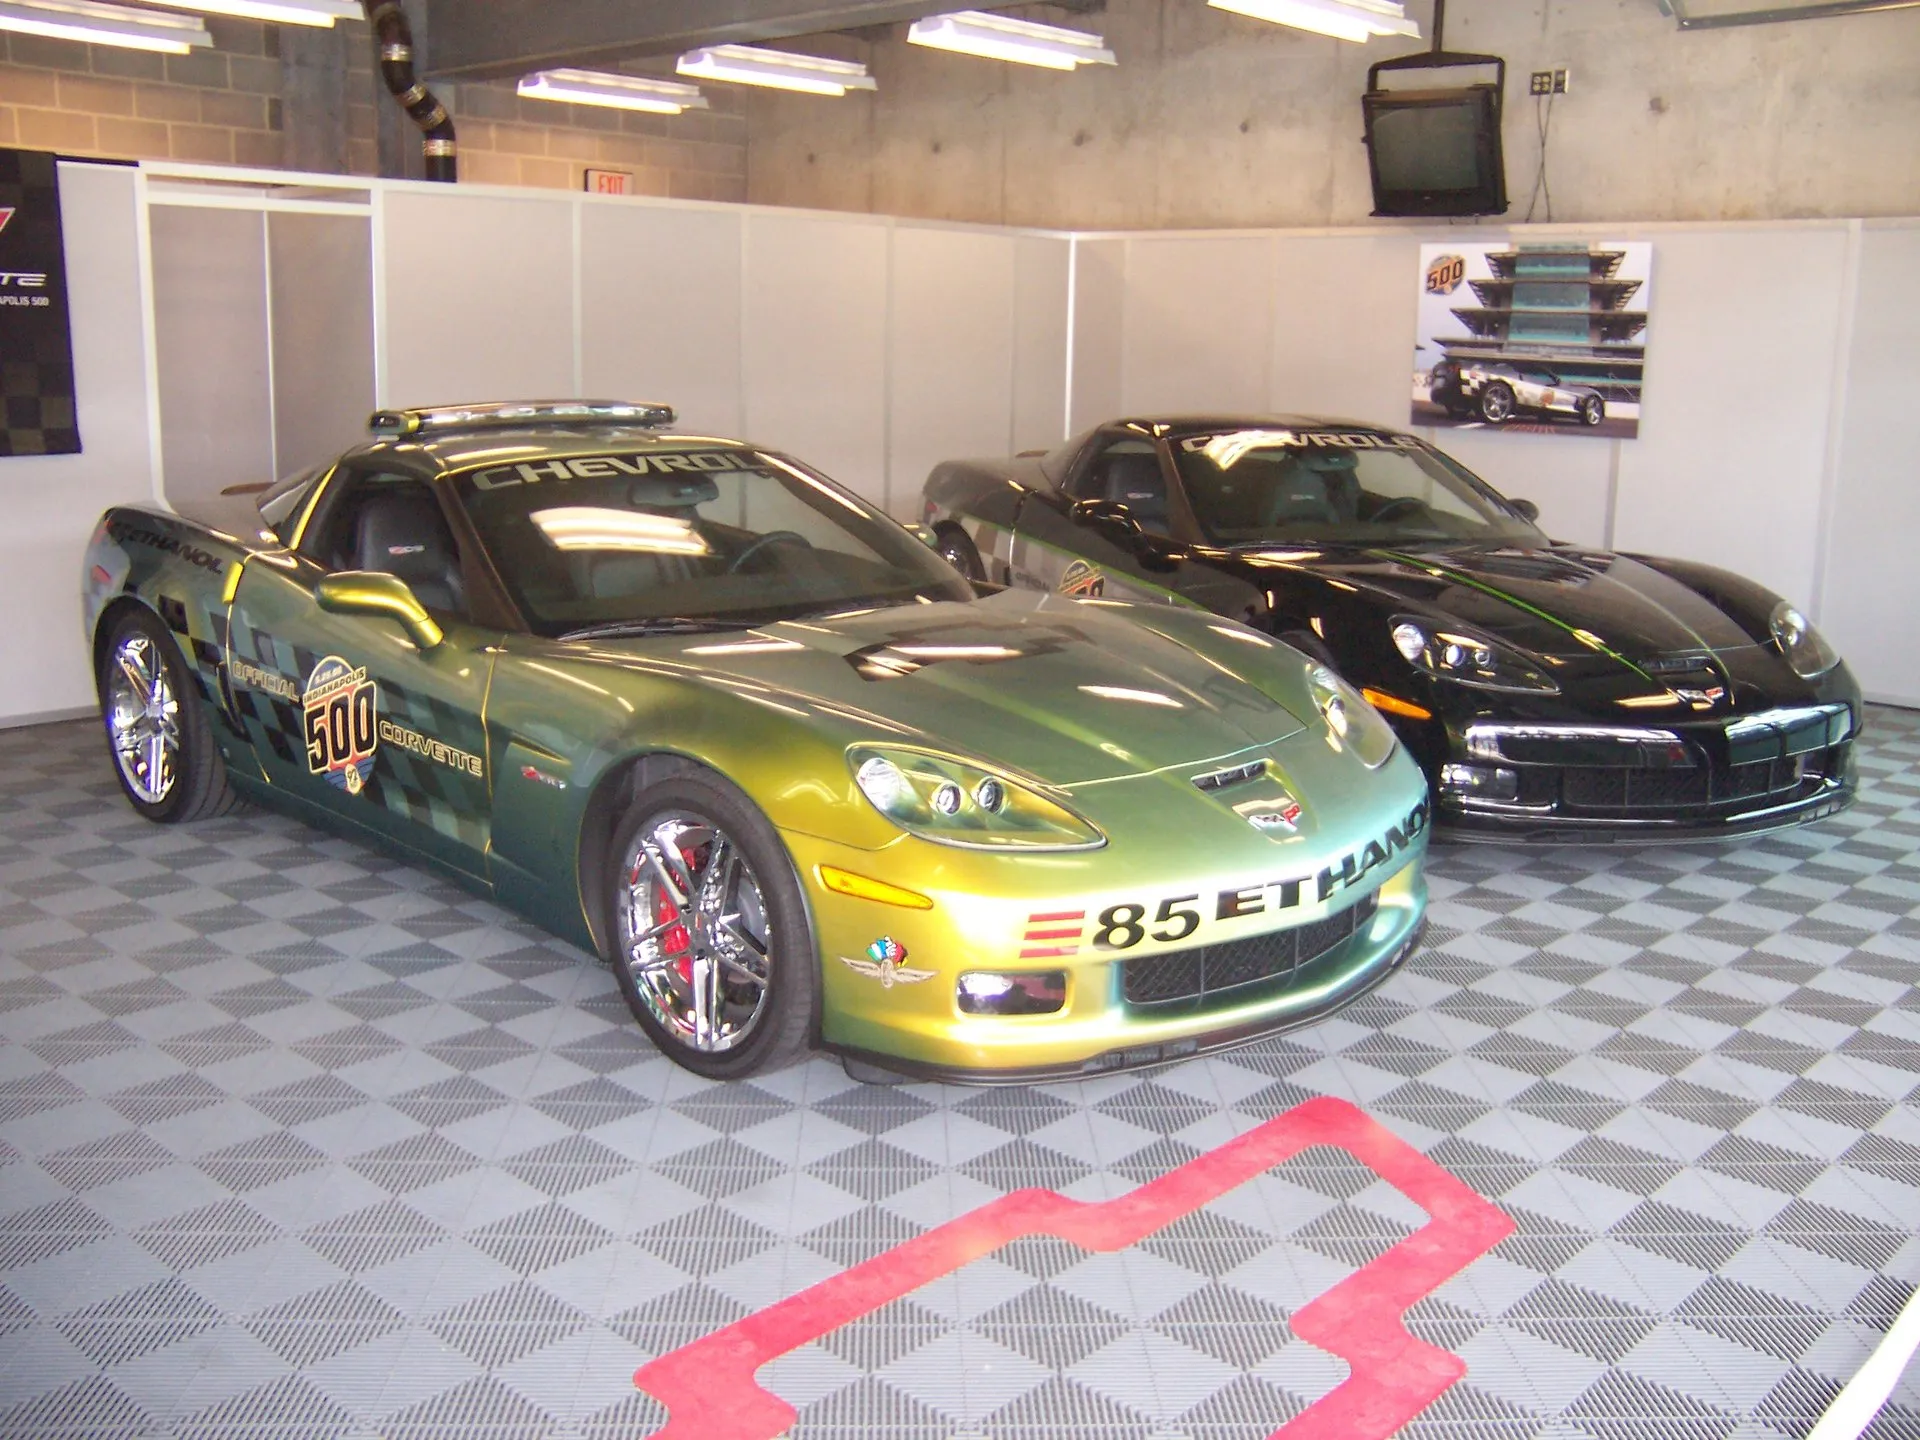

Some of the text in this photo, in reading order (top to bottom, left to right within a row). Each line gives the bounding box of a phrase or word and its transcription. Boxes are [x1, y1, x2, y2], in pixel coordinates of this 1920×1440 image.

[598, 174, 625, 195] EXIT
[1427, 259, 1463, 292] 500
[31, 296, 50, 307] 500
[232, 660, 300, 703] OFFICIAL
[303, 667, 365, 704] INDIANAPOLIS
[305, 681, 376, 773] 500
[379, 720, 483, 777] CORVETTE
[1215, 796, 1428, 921] ETHANO
